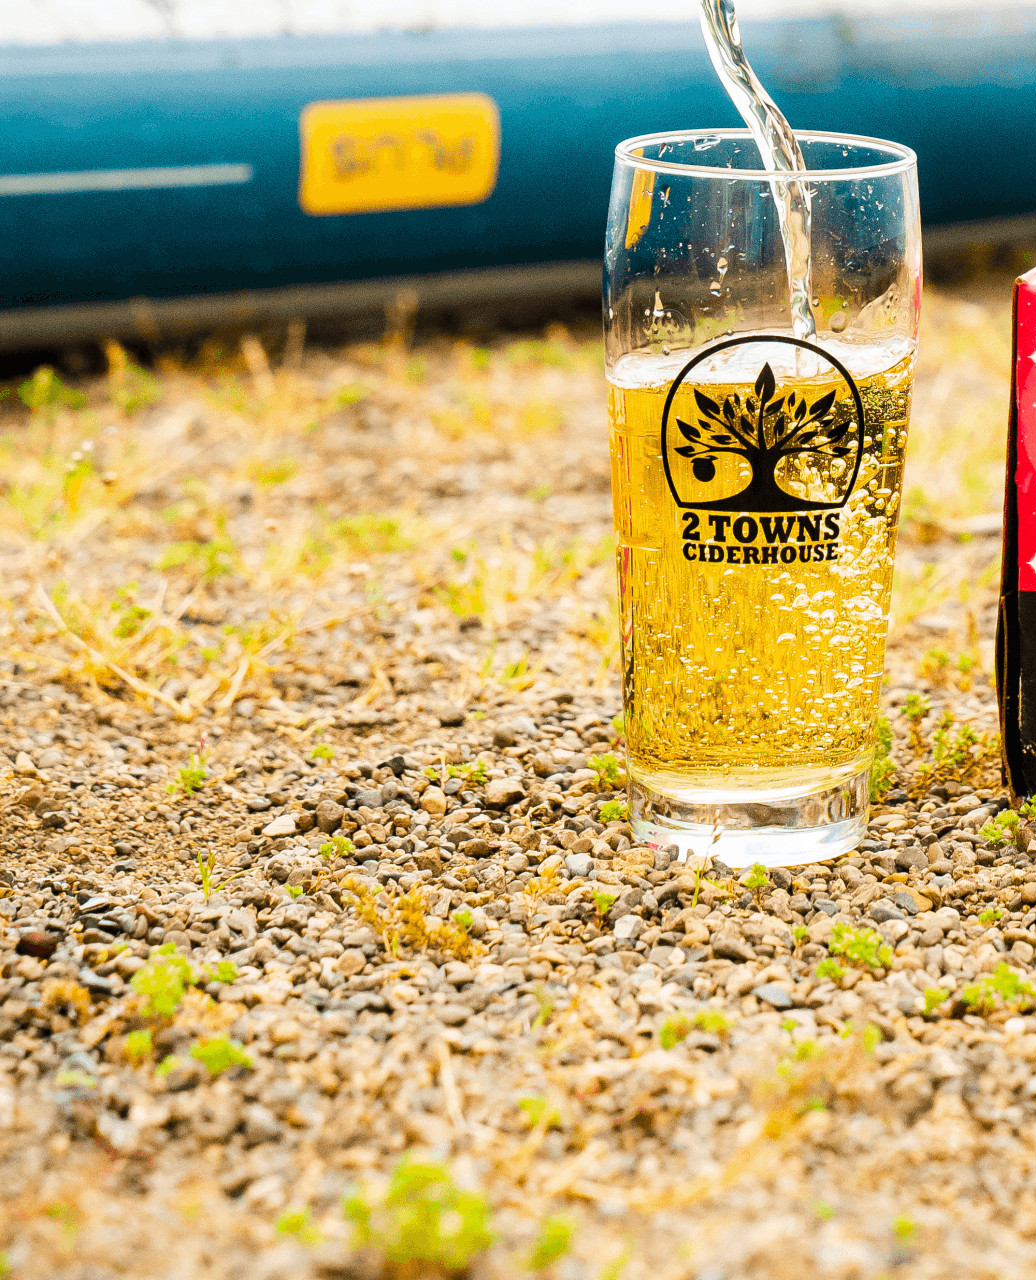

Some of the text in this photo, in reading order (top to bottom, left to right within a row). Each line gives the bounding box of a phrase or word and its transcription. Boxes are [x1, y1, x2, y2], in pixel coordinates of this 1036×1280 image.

[682, 512, 840, 543] 2 TOWNS
[682, 542, 839, 564] CIDERHOUSE
